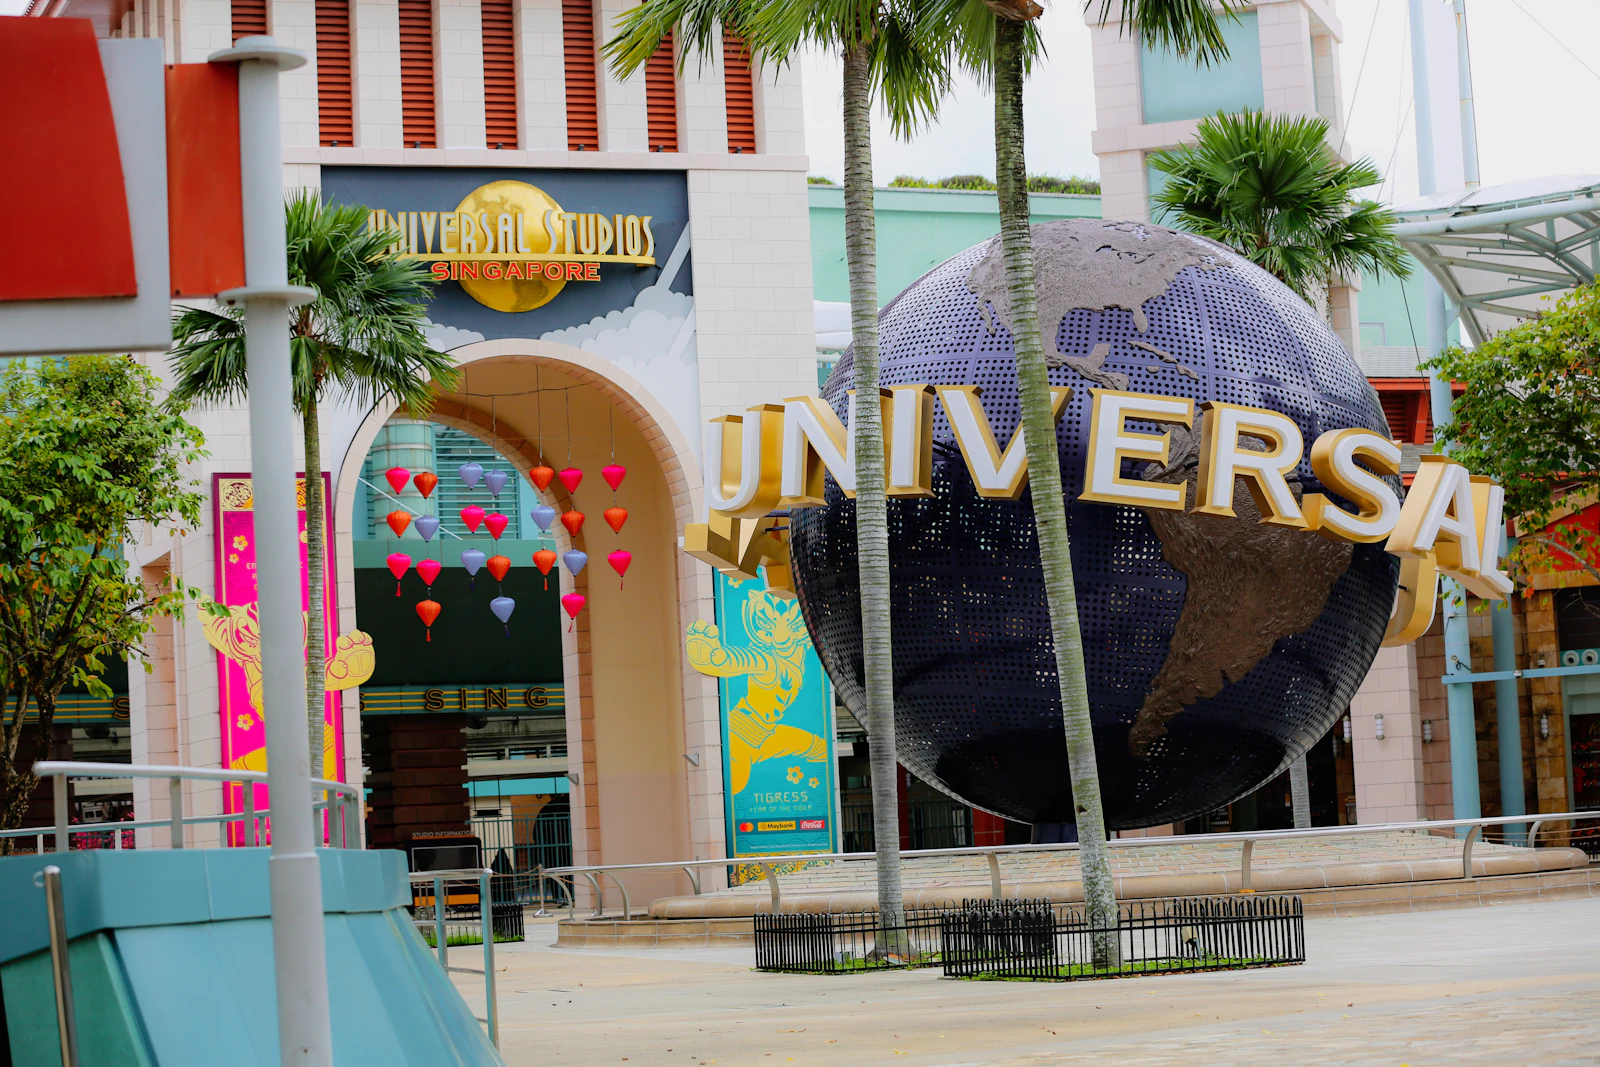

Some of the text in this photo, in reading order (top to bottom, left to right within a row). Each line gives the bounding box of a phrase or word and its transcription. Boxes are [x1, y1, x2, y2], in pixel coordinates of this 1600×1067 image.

[366, 209, 655, 257] UNIVERSAL STUDIOS
[431, 261, 602, 281] SINGAPORE
[702, 384, 1515, 599] UNIVERSAL
[753, 791, 809, 804] TIGRESS
